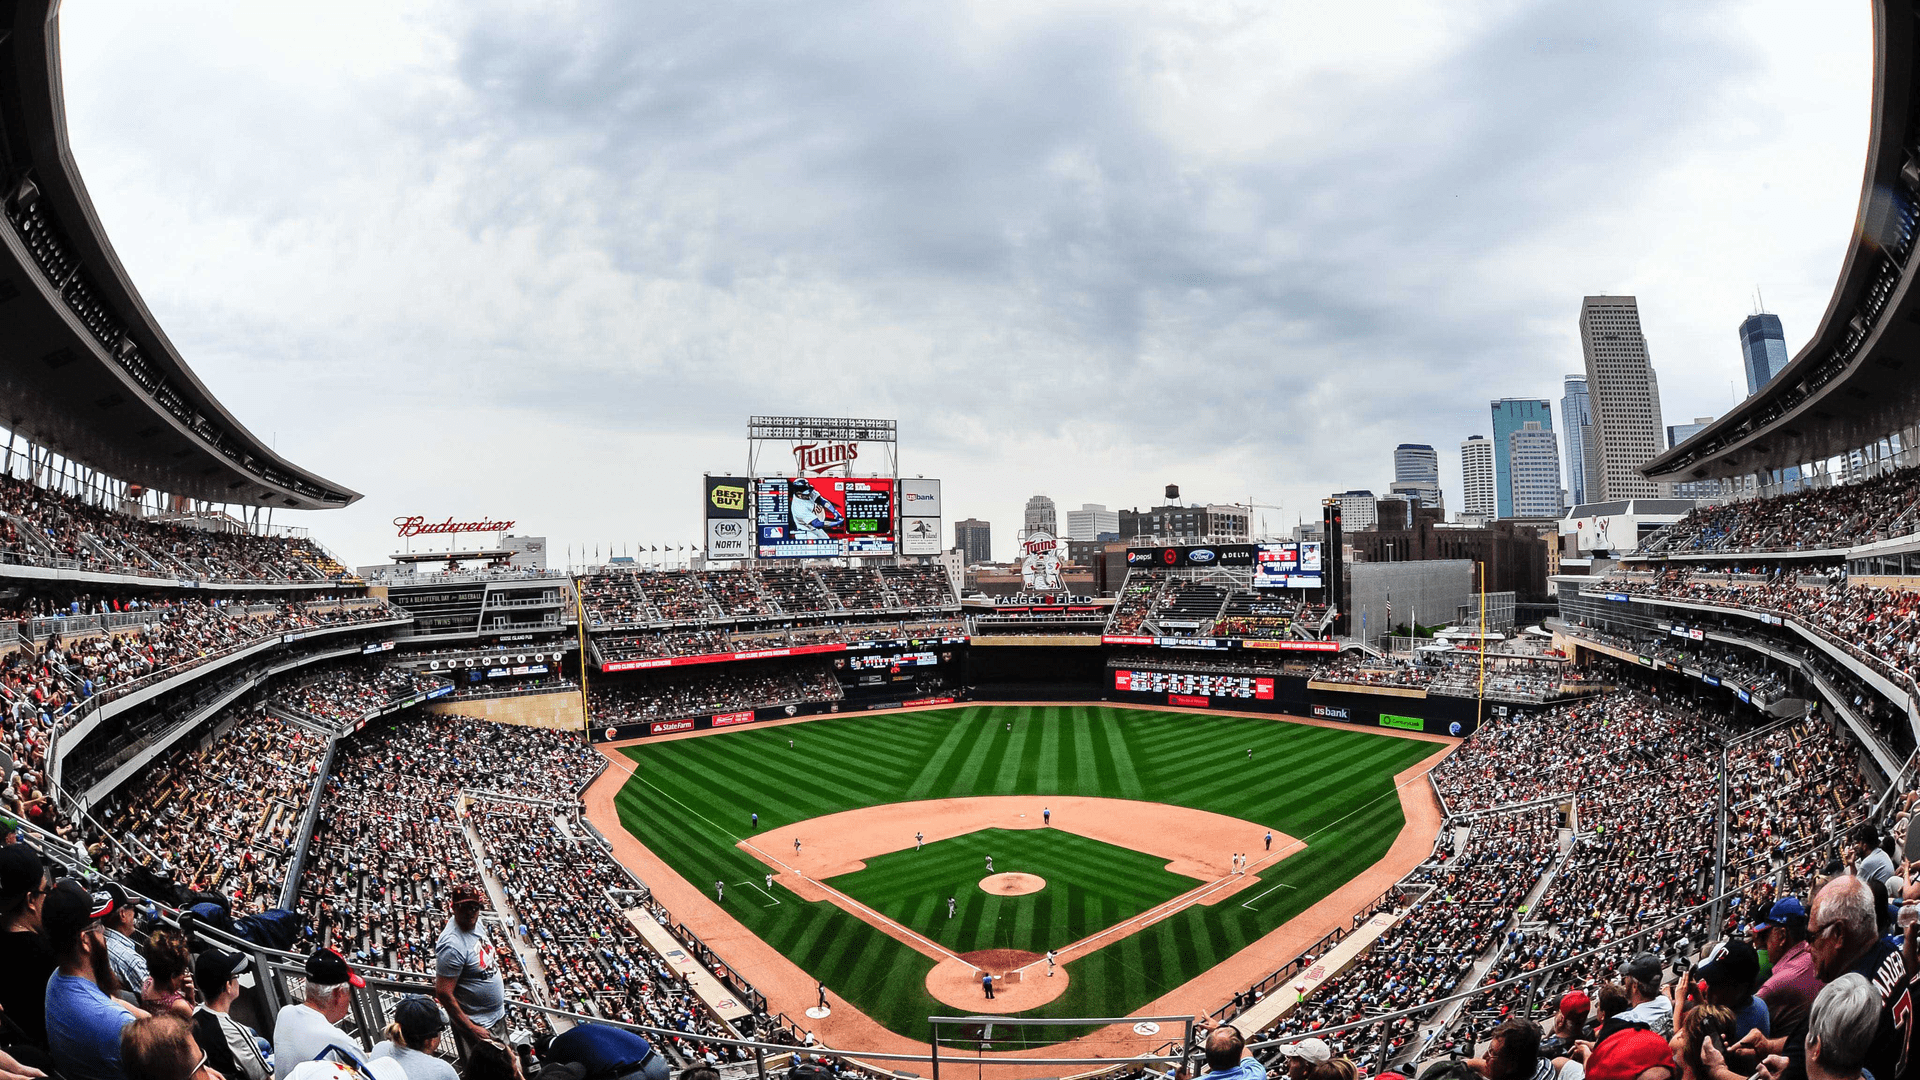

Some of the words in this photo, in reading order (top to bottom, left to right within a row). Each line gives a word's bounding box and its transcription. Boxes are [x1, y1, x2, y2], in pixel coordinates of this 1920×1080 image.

[793, 440, 858, 474] Twins
[716, 489, 744, 499] BEST
[716, 497, 741, 506] BUY
[393, 516, 515, 537] Budweiser
[720, 523, 736, 532] FOX
[715, 540, 742, 549] NORTH
[1023, 538, 1057, 555] Twins
[1136, 552, 1152, 561] pepsi
[994, 596, 1043, 605] TARGET
[1056, 595, 1093, 604] FIELD
[1892, 987, 1913, 1079] 7
